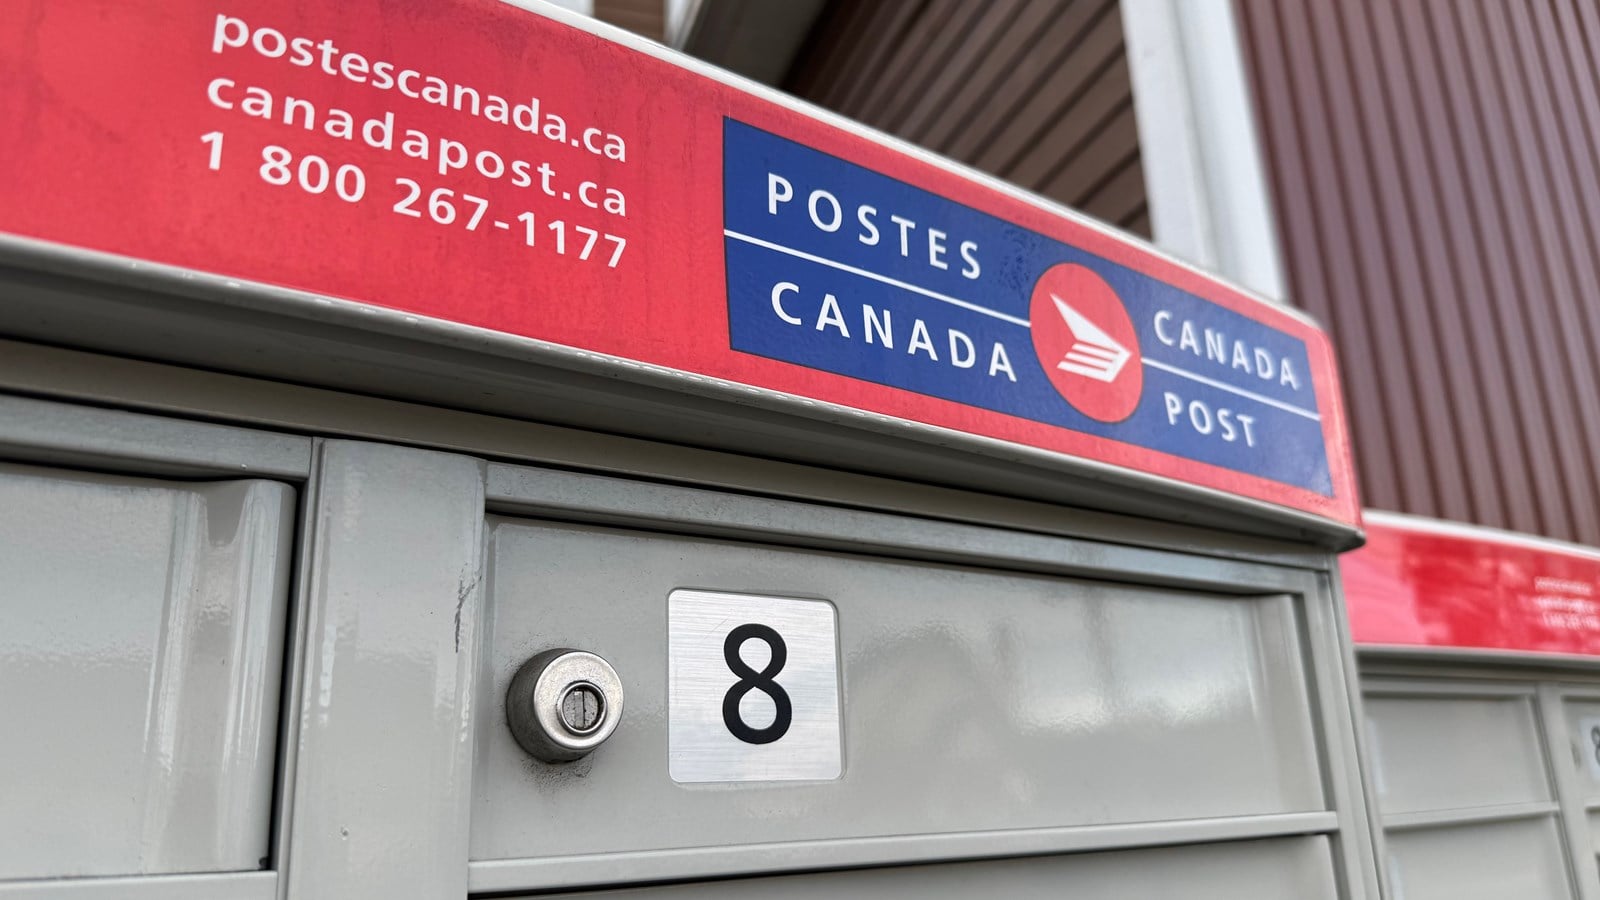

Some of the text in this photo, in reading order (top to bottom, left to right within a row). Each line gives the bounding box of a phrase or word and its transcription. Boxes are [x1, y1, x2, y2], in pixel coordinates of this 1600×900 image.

[212, 14, 627, 162] postescanada.ca
[200, 131, 627, 268] 1 800 267-1177
[207, 78, 627, 216] canadapost.ca
[767, 172, 982, 280] POSTES
[770, 282, 1018, 383] CANADA
[1154, 310, 1301, 391] CANADA
[1164, 392, 1257, 447] POST
[722, 623, 793, 745] 8
